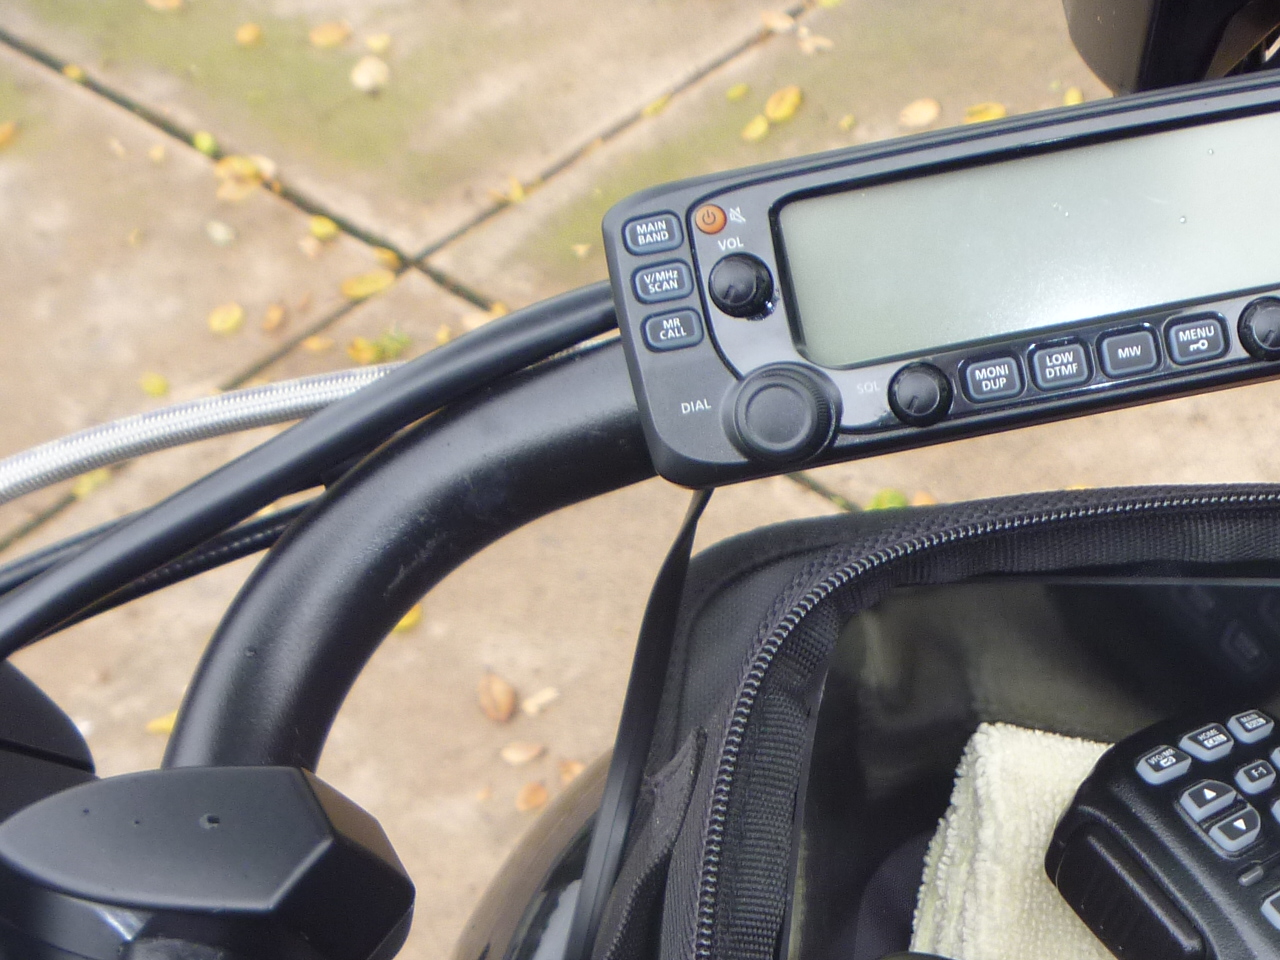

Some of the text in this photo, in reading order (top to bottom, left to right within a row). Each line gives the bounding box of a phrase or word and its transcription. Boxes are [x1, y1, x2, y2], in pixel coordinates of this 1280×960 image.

[636, 220, 667, 235] MAIN
[637, 230, 669, 245] BAND
[718, 236, 744, 250] VOL
[644, 269, 678, 284] V/MHz
[648, 280, 678, 294] SCAN
[663, 318, 681, 330] MR
[659, 327, 687, 340] CALL
[1178, 326, 1215, 343] MENU
[1046, 351, 1074, 367] LOW
[1117, 344, 1142, 359] MW
[975, 364, 1009, 381] MONI
[1046, 362, 1079, 379] DTMF
[857, 380, 881, 394] SQL
[982, 376, 1007, 391] DUP
[681, 398, 712, 414] DIAL
[1197, 728, 1220, 742] HOME
